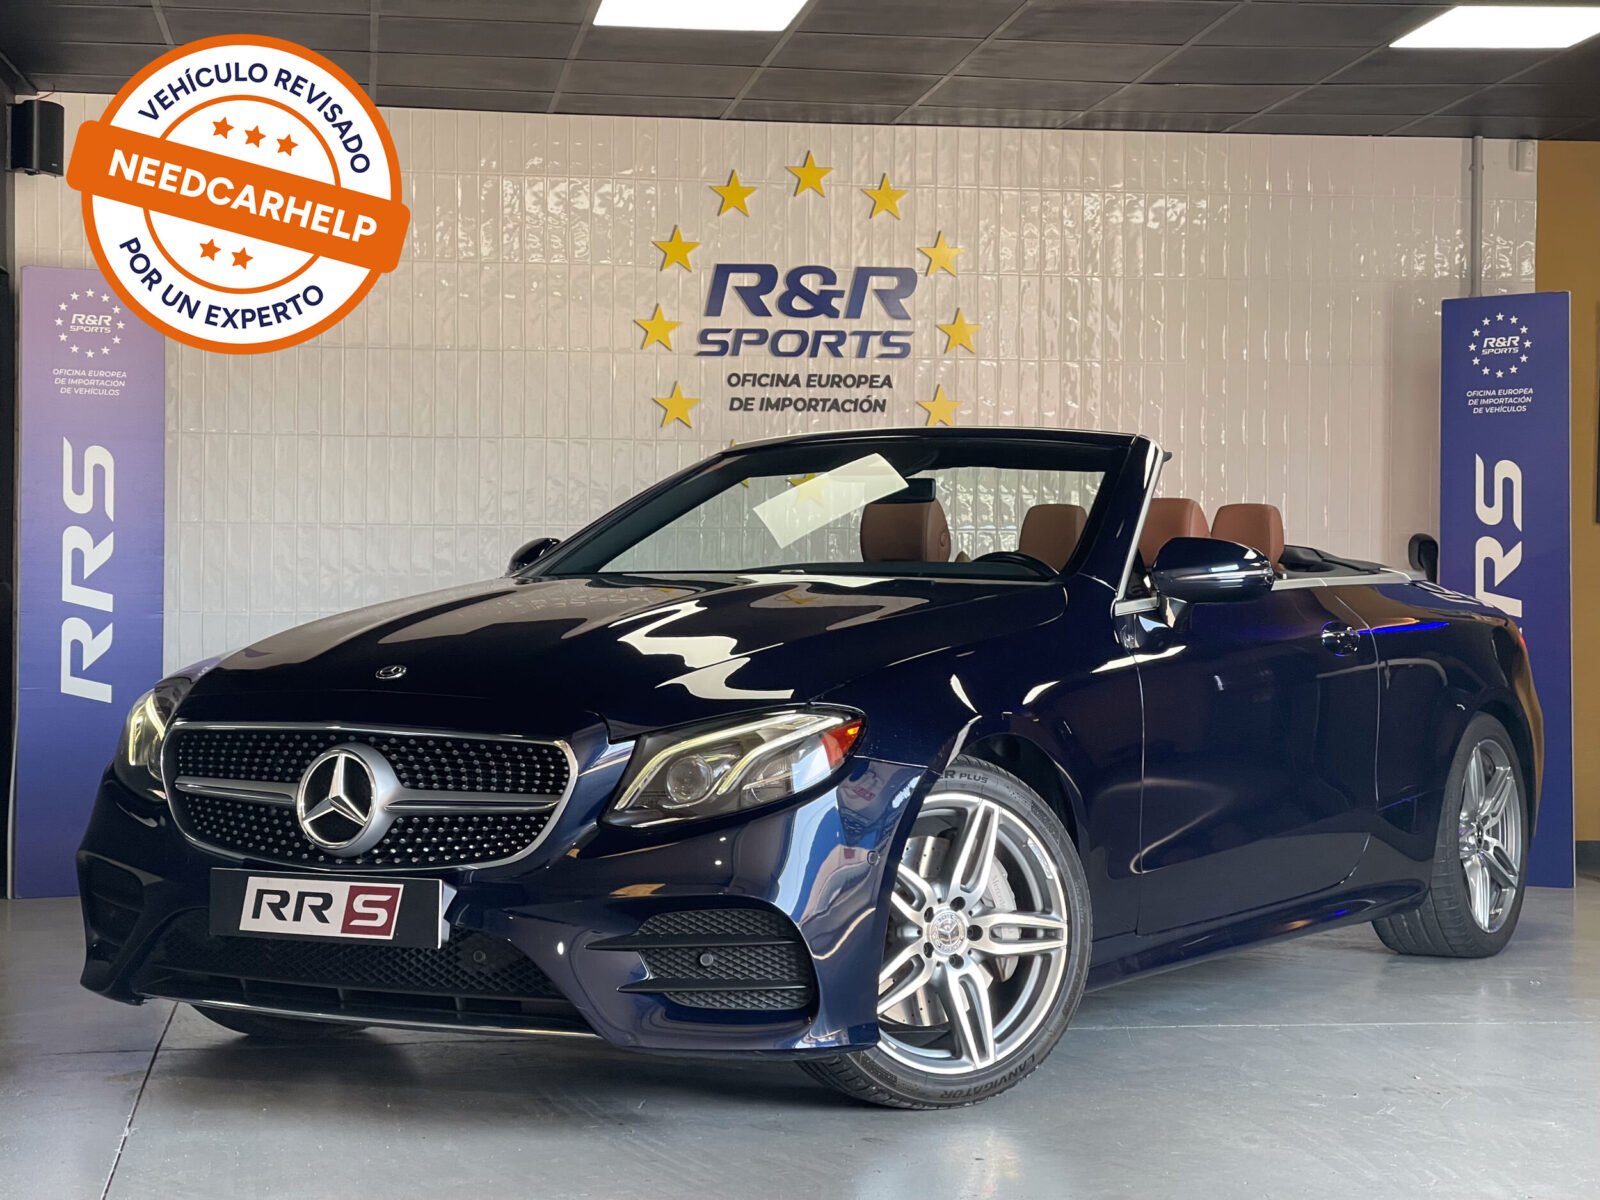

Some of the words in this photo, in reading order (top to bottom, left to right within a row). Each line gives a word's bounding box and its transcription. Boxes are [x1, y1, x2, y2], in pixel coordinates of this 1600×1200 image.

[703, 263, 918, 320] R&R
[71, 313, 112, 326] R&R
[69, 325, 112, 333] SPORTS
[694, 328, 914, 359] SPORTS
[1483, 336, 1520, 348] R&R
[1481, 347, 1519, 355] SPORTS
[52, 368, 86, 377] OFICINA
[88, 369, 127, 378] EUROPEA
[54, 377, 67, 385] DE
[68, 377, 126, 387] IMPORTACIÓN
[727, 373, 801, 388] OFICINA
[806, 374, 893, 389] EUROPEA
[60, 387, 72, 395] DE
[73, 387, 120, 396] VEHÍCULOS
[1466, 389, 1496, 397] OFICINA
[1498, 387, 1534, 396] EUROPEA
[729, 397, 755, 412] DE
[759, 395, 886, 413] IMPORTACIÓN
[1480, 396, 1532, 405] IMPORTACIÓN
[1485, 405, 1527, 413] VEHÍCULOS
[1475, 452, 1523, 634] RS
[61, 436, 115, 703] RRS
[959, 772, 989, 784] PLUS
[939, 1053, 1036, 1099] LANVIGATOR
